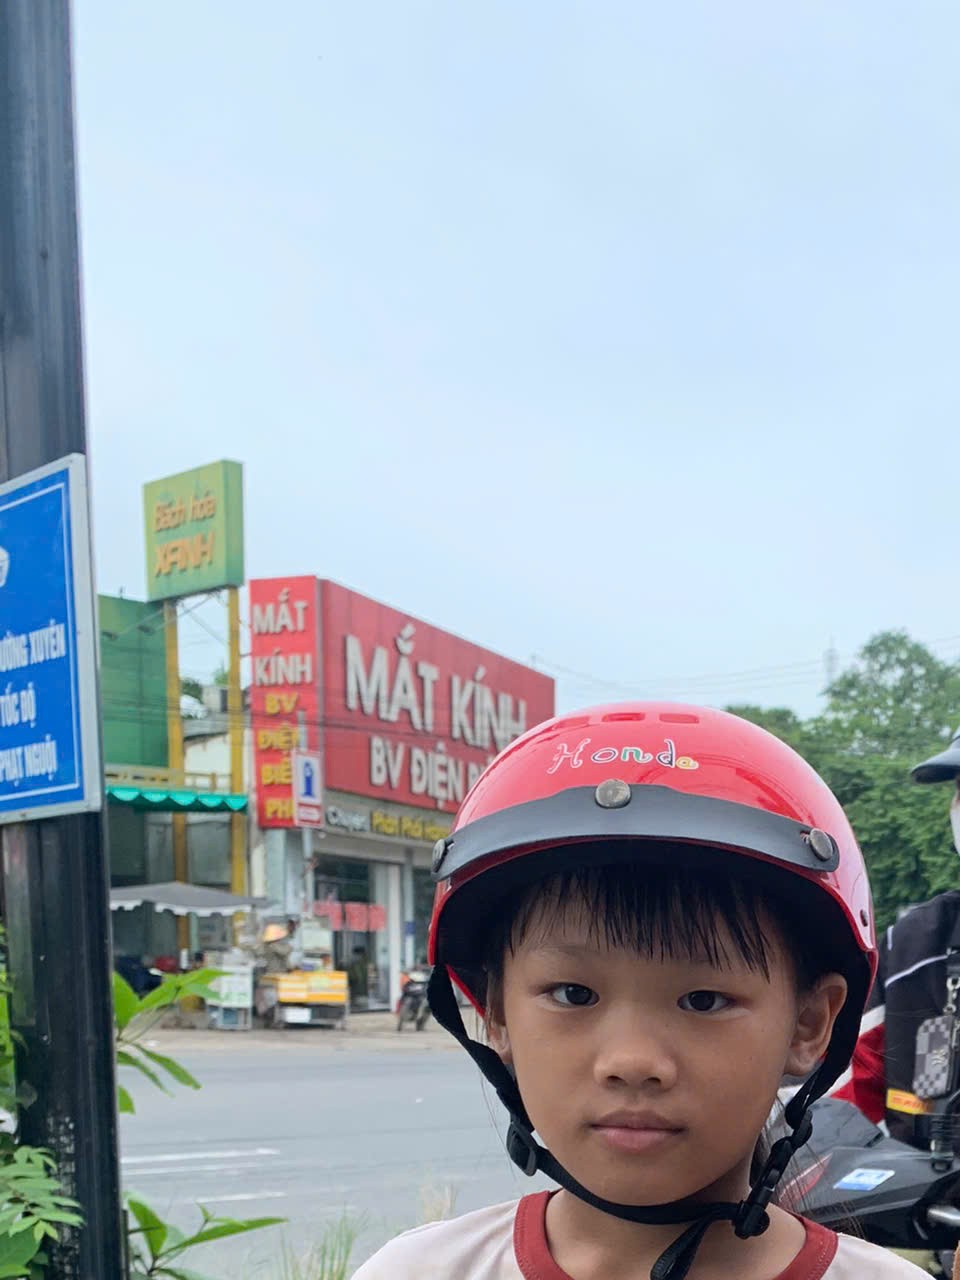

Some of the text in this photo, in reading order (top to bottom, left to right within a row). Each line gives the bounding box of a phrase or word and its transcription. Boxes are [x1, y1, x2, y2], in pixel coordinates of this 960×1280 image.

[252, 587, 308, 635] MẮT
[254, 650, 312, 687] KÍNH
[345, 624, 439, 732] MẮT
[265, 691, 298, 715] BV
[370, 736, 405, 789] BV
[410, 740, 464, 809] ĐIỆN
[546, 737, 700, 774] Honda
[265, 797, 293, 819] PH
